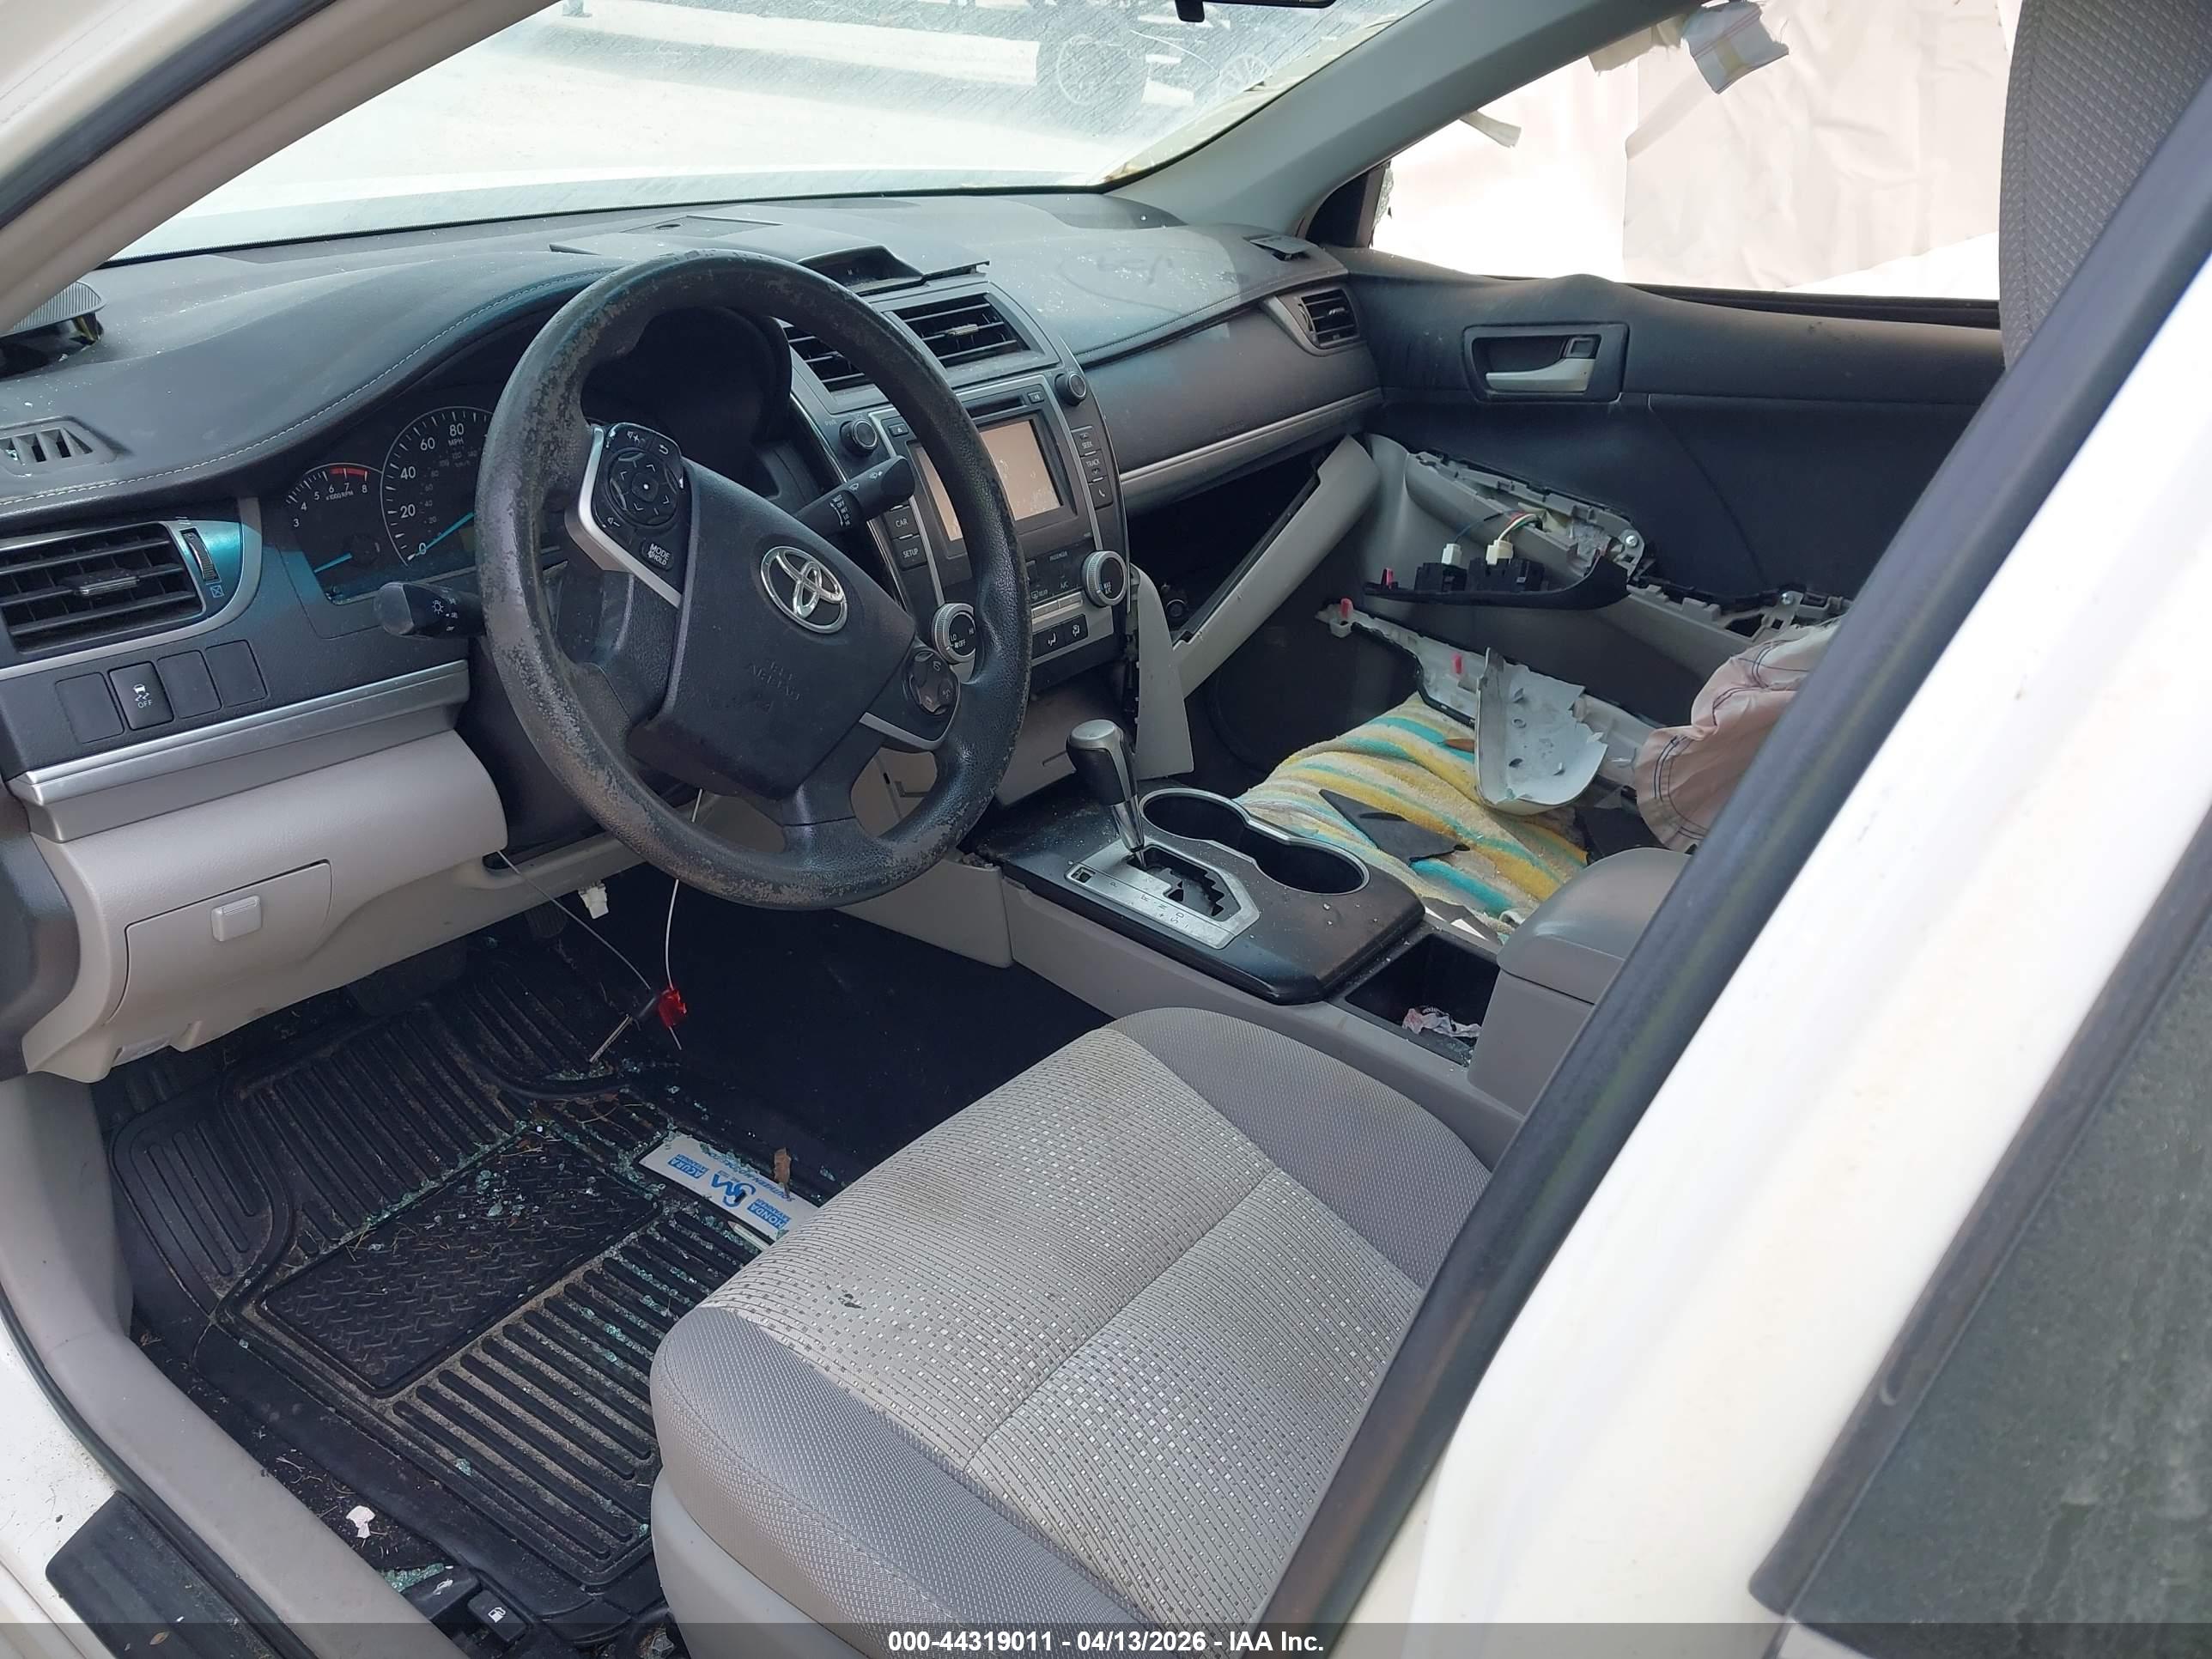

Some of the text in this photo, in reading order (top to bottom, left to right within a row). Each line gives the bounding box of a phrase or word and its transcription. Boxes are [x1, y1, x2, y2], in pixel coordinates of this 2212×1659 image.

[449, 422, 465, 437] 80
[420, 436, 435, 451] 60
[448, 438, 464, 447] MPH
[400, 465, 416, 480] 40
[328, 483, 335, 494] 6
[344, 483, 350, 492] 7
[362, 484, 368, 494] 8
[314, 491, 321, 501] 5
[301, 501, 307, 511] 4
[400, 503, 416, 519] 20
[293, 518, 300, 528] 3
[895, 518, 908, 528] CAR
[418, 542, 427, 555] 0
[650, 543, 671, 561] MODE
[902, 548, 919, 558] SETUP
[950, 633, 957, 641] LO
[137, 699, 152, 708] OFF
[670, 1157, 705, 1177] ACURA
[750, 1203, 785, 1228] HONDA
